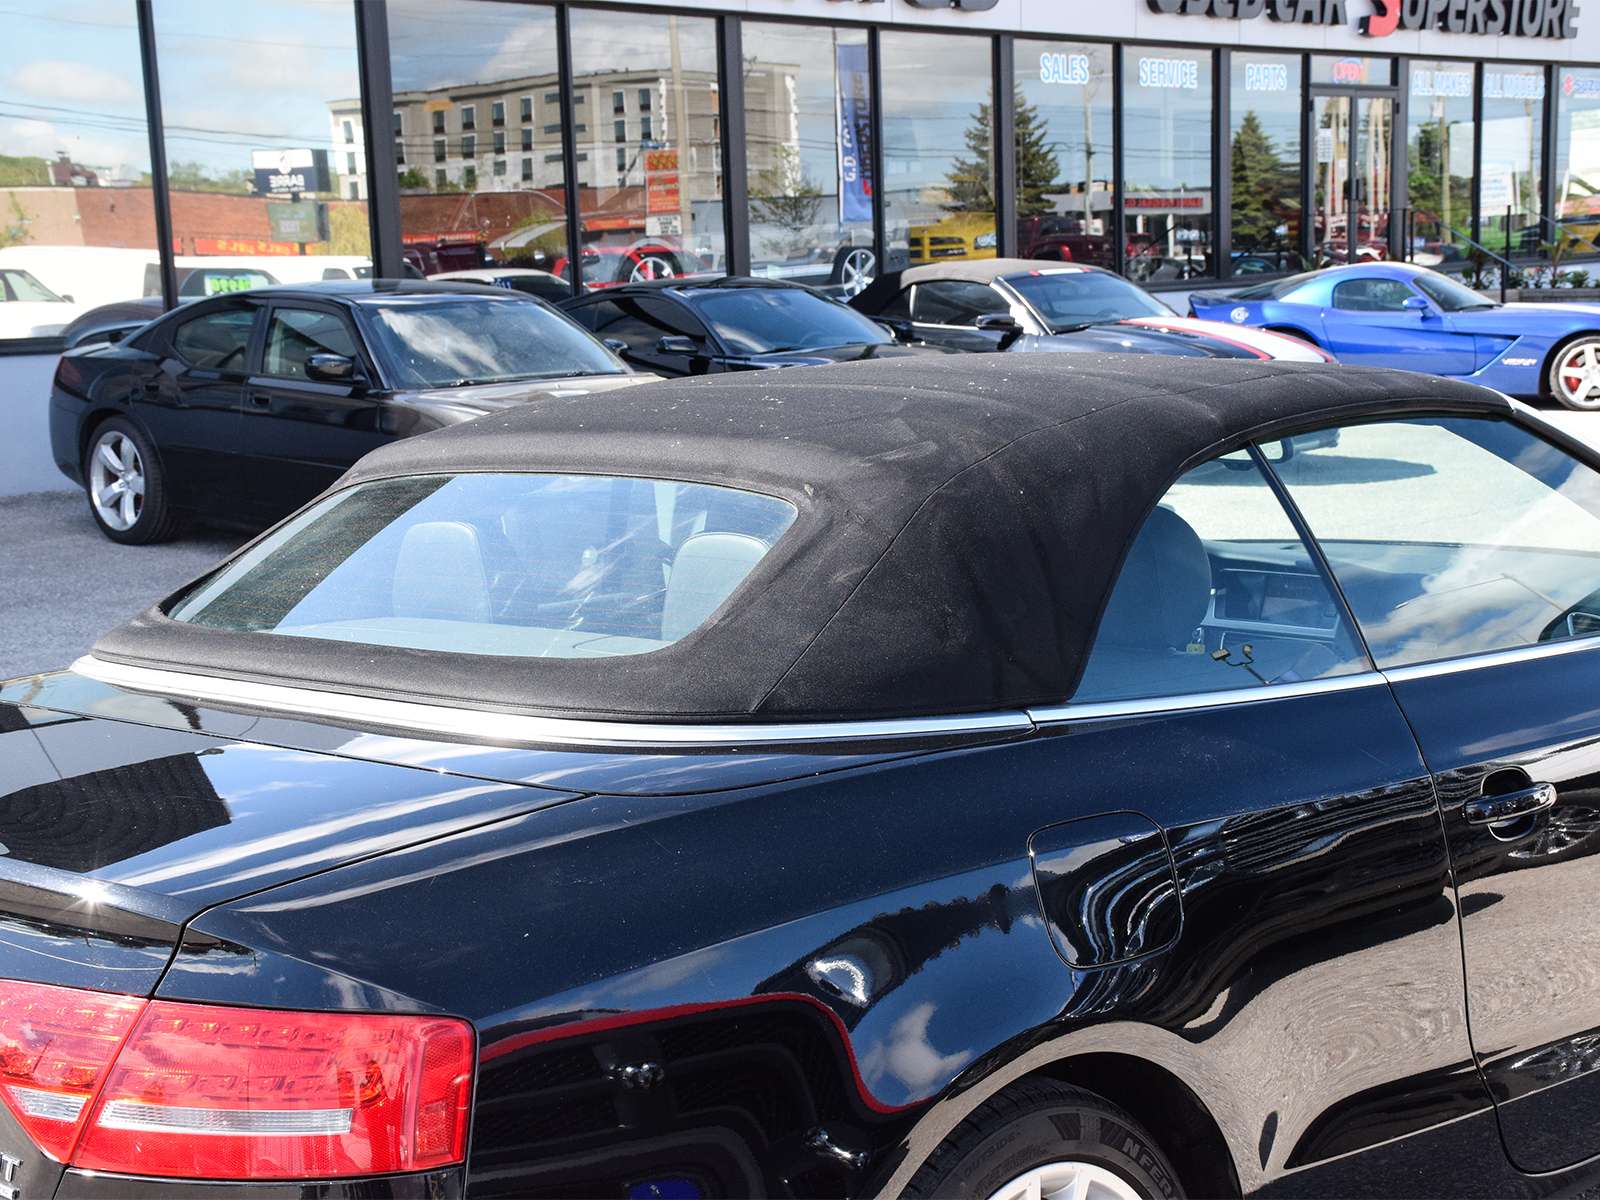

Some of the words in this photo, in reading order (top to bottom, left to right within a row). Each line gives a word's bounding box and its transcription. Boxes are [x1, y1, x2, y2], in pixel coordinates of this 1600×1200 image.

[1040, 53, 1089, 84] SALES
[1139, 58, 1198, 89] SERVICE
[1246, 64, 1288, 91] PARTS
[1412, 70, 1433, 96] ALL
